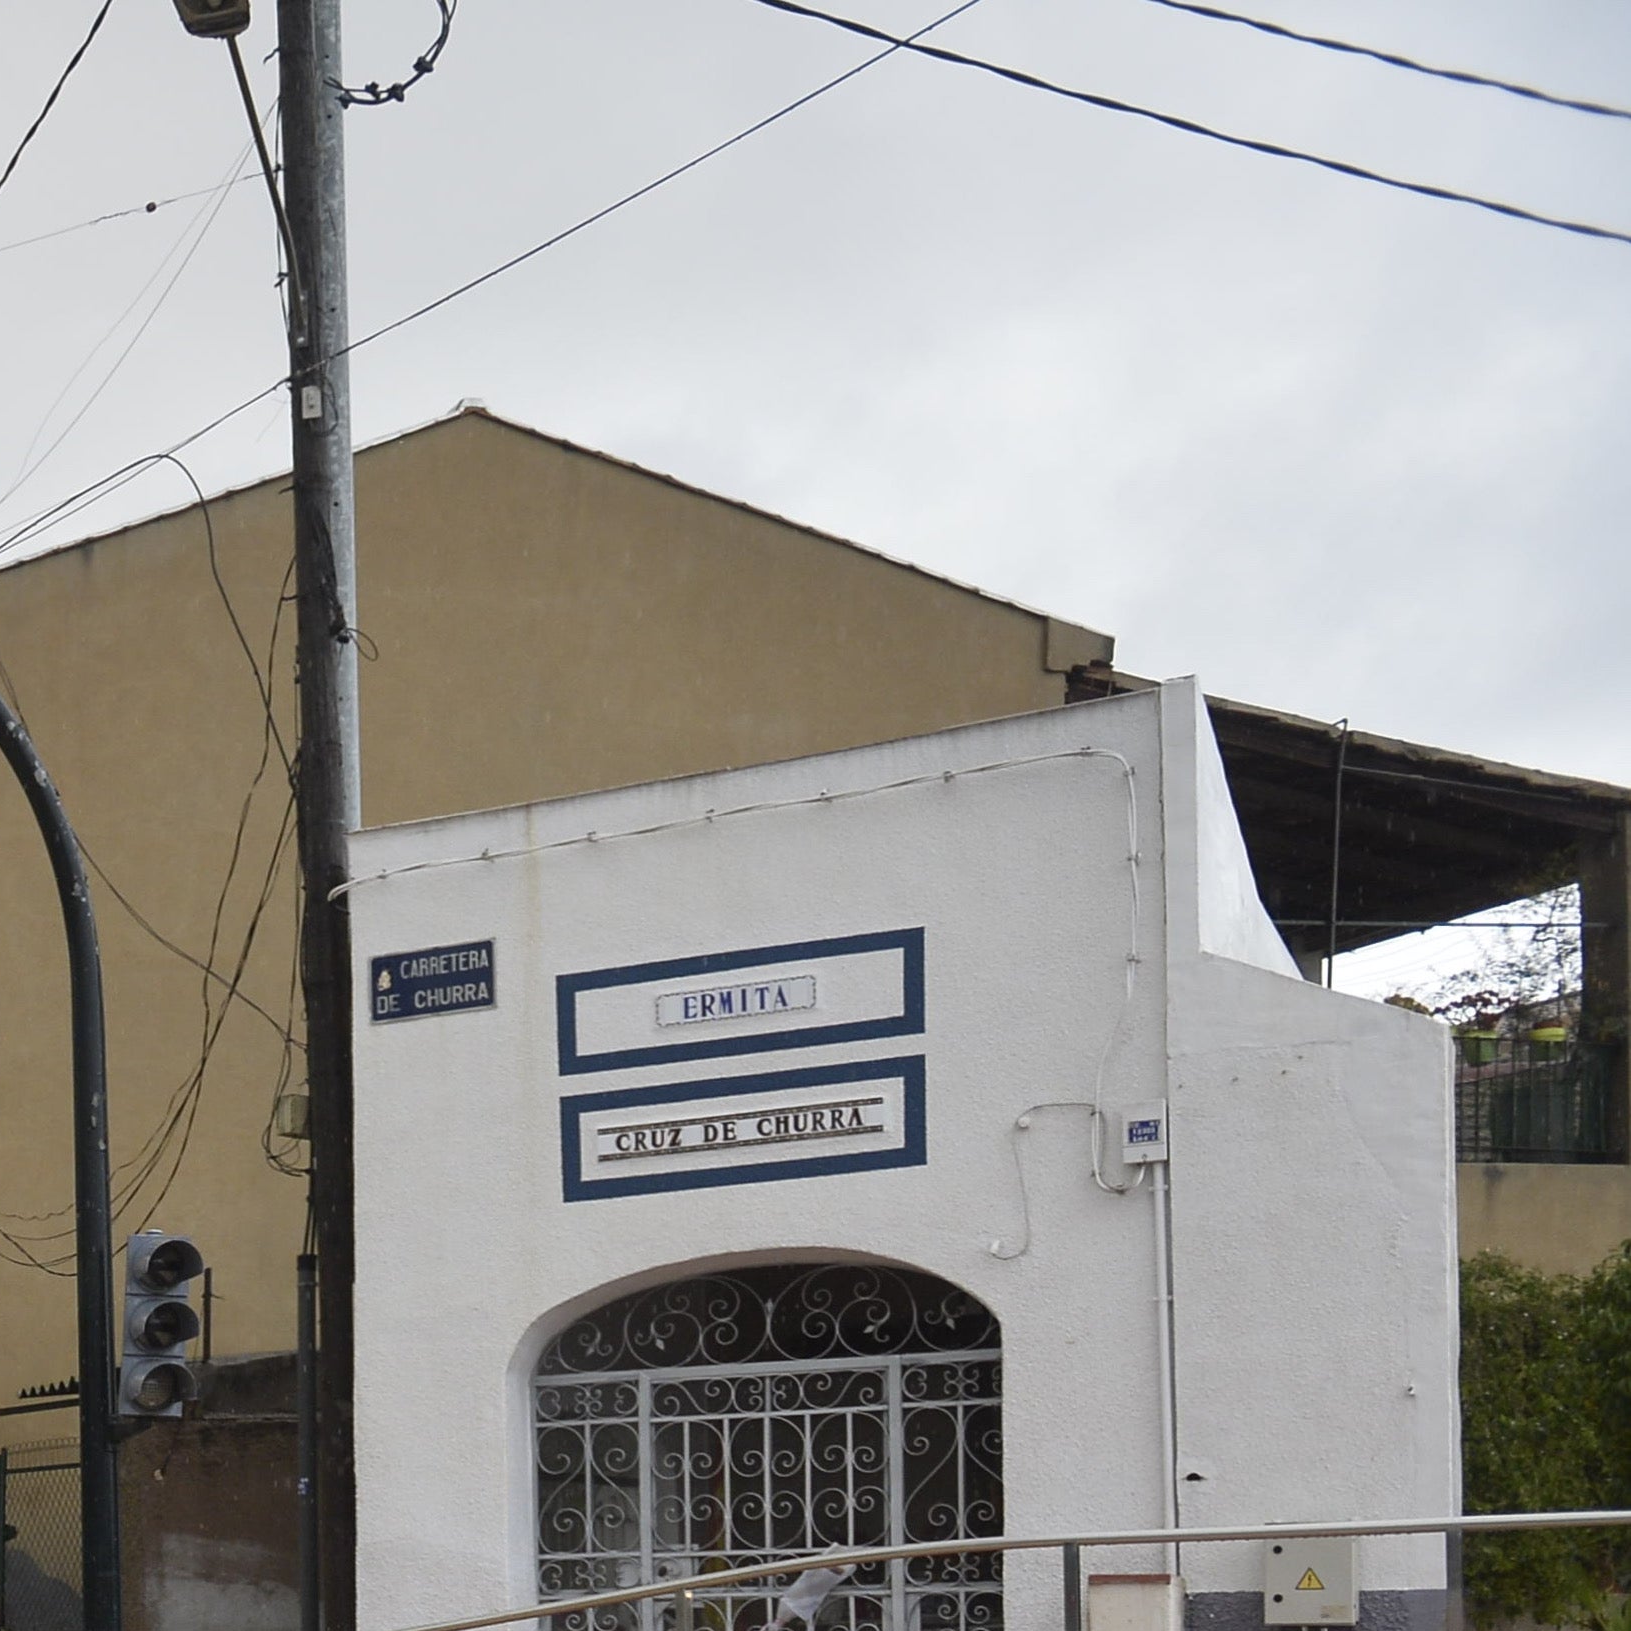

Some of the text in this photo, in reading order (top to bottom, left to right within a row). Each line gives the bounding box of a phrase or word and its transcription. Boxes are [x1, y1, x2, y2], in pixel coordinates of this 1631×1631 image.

[400, 949, 490, 979] CARRETERA
[376, 982, 490, 1015] DE CHURRA
[683, 984, 788, 1020] ERMITA
[615, 1108, 865, 1152] CRUZ DE CHURRA
